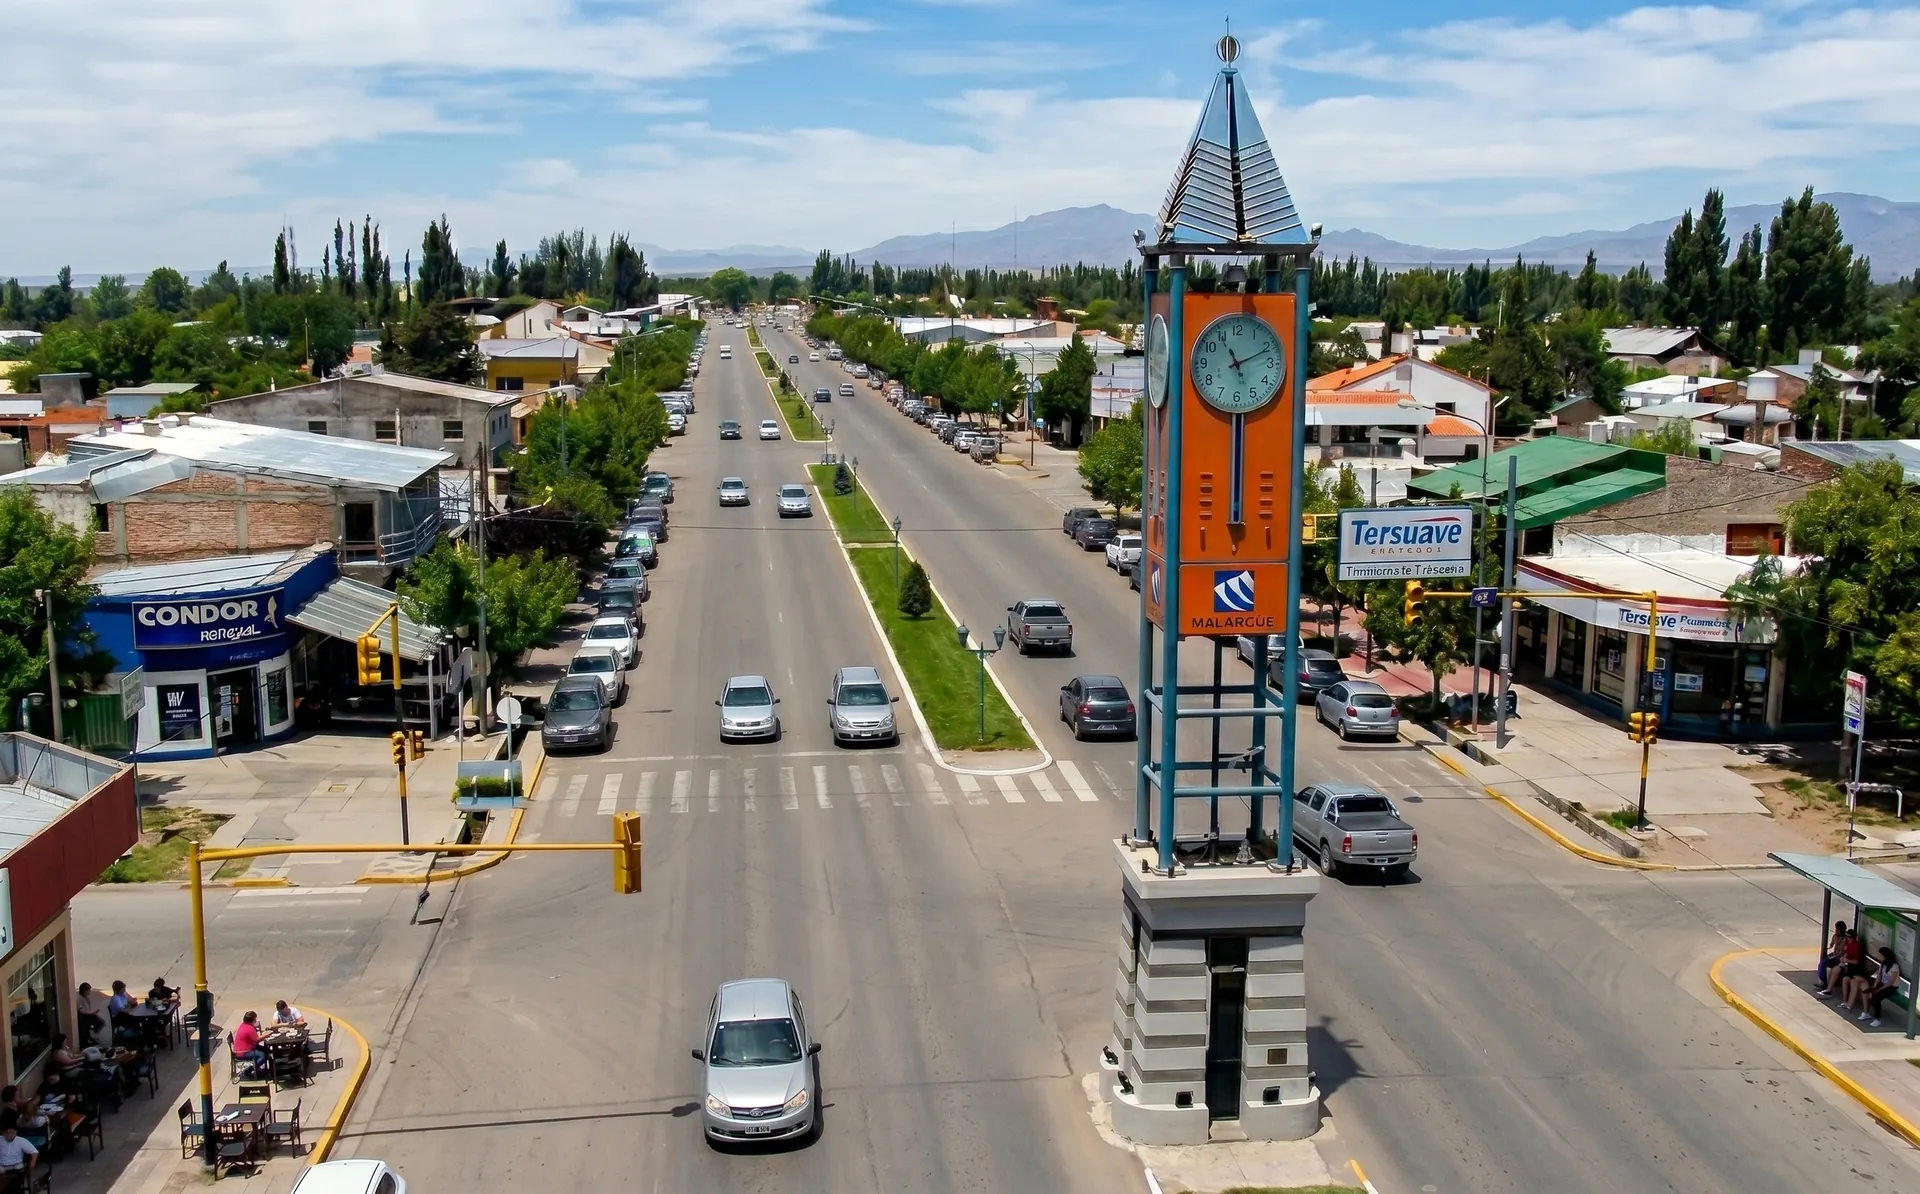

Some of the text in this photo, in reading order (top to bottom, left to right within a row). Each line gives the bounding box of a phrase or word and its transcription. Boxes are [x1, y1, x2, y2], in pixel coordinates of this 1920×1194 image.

[1232, 325, 1243, 336] 12
[1205, 341, 1217, 353] 10
[1263, 342, 1270, 353] 2
[1200, 357, 1208, 369] 9
[1266, 357, 1274, 369] 3
[1205, 374, 1213, 386] 8
[1260, 374, 1269, 385] 4
[1217, 386, 1225, 398] 7
[1233, 391, 1241, 402] 6
[1249, 387, 1257, 398] 5
[1351, 519, 1462, 546] Tersuave
[138, 600, 259, 627] CONDOR
